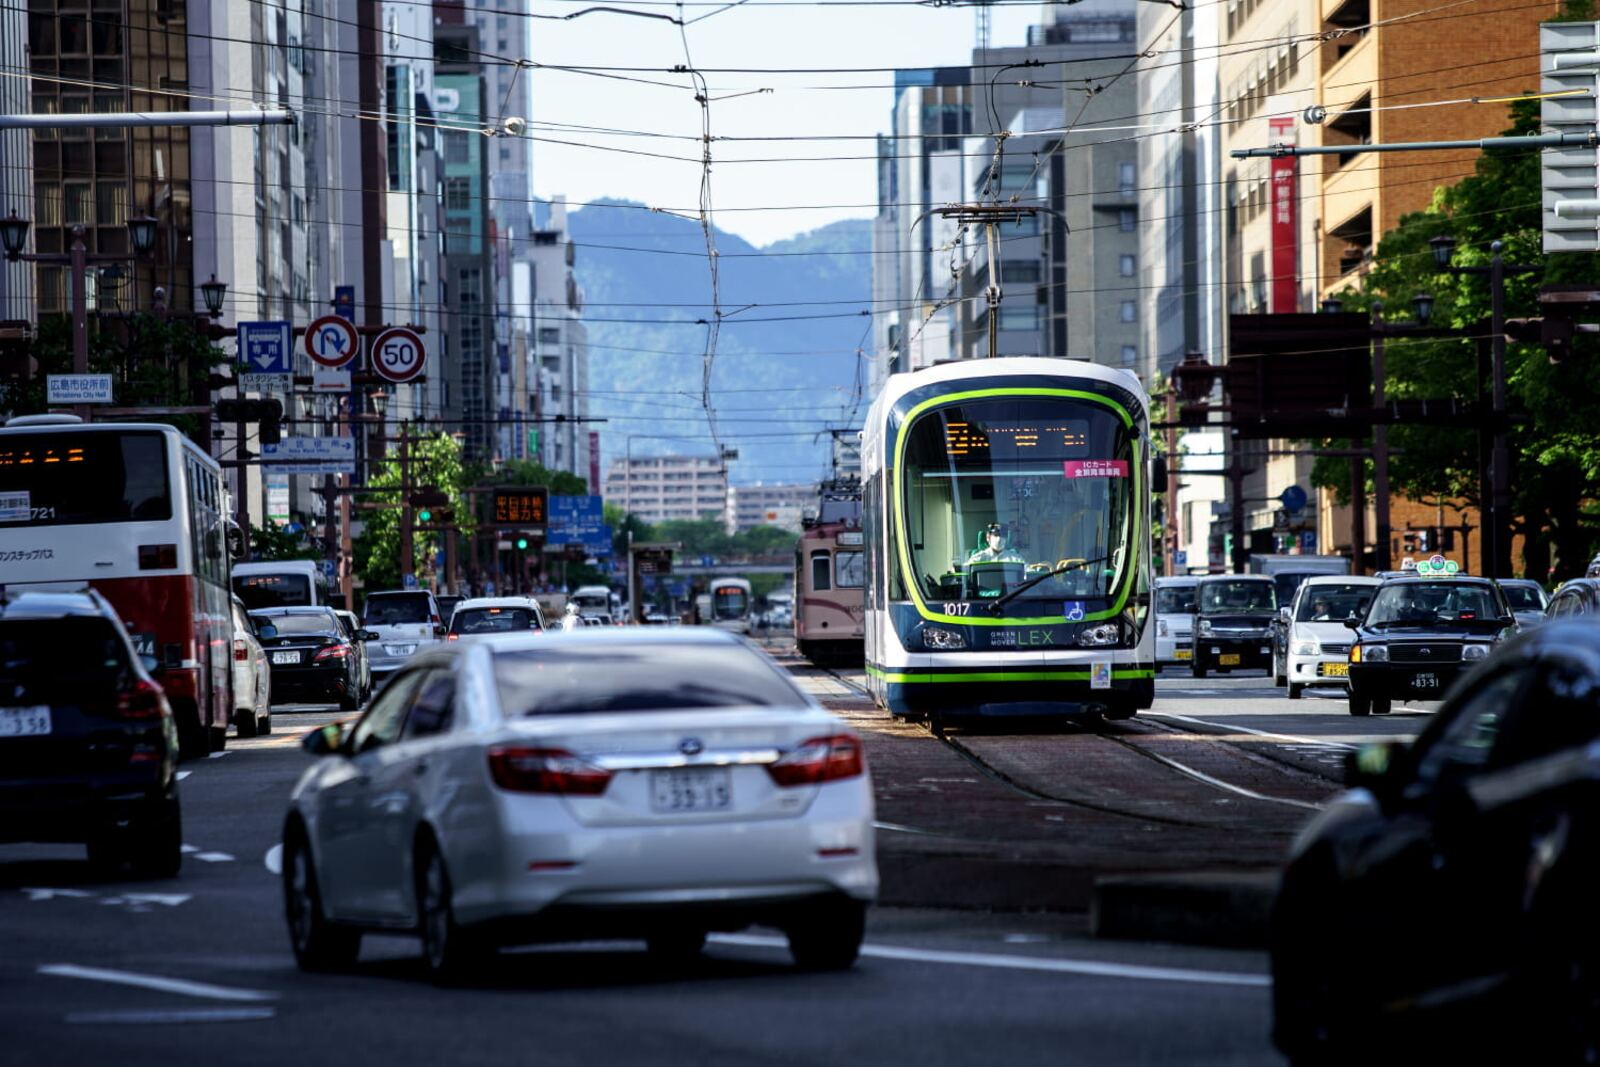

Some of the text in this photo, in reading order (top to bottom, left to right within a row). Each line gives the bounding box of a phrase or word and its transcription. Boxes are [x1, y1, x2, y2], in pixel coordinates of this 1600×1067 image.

[384, 343, 413, 366] 50
[50, 379, 109, 390] 広島市役所前
[83, 391, 94, 399] City
[1083, 461, 1112, 469] ICカード
[30, 507, 56, 519] 721
[943, 602, 970, 616] 1017
[1018, 630, 1054, 645] LEX
